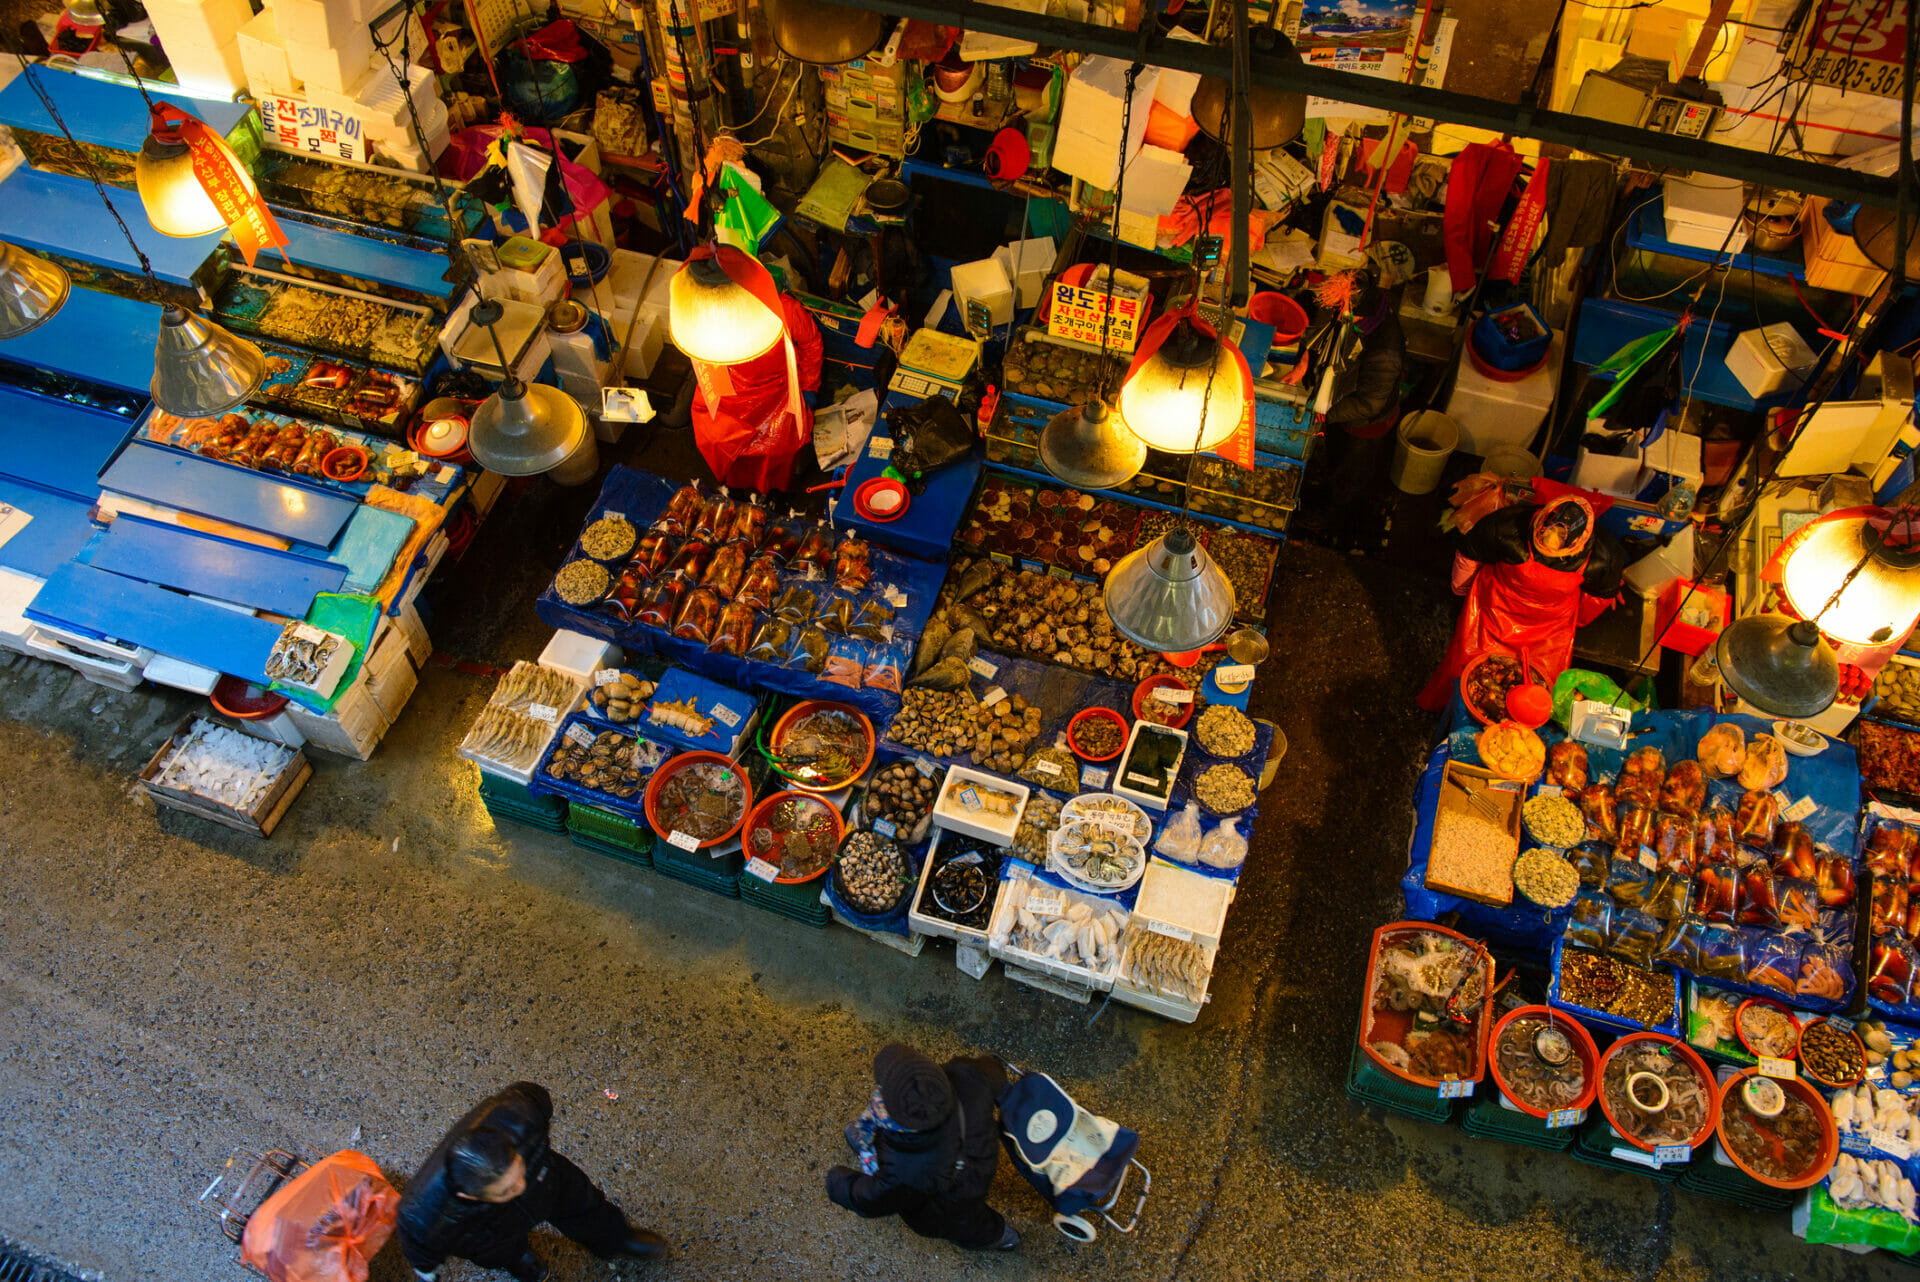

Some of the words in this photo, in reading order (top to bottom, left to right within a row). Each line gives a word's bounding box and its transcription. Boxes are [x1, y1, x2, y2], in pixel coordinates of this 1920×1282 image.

[262, 101, 276, 133] 완도
[277, 99, 300, 148] 전복
[297, 107, 361, 140] 조개구이
[320, 129, 337, 144] 찜
[1053, 313, 1096, 333] 조개구이
